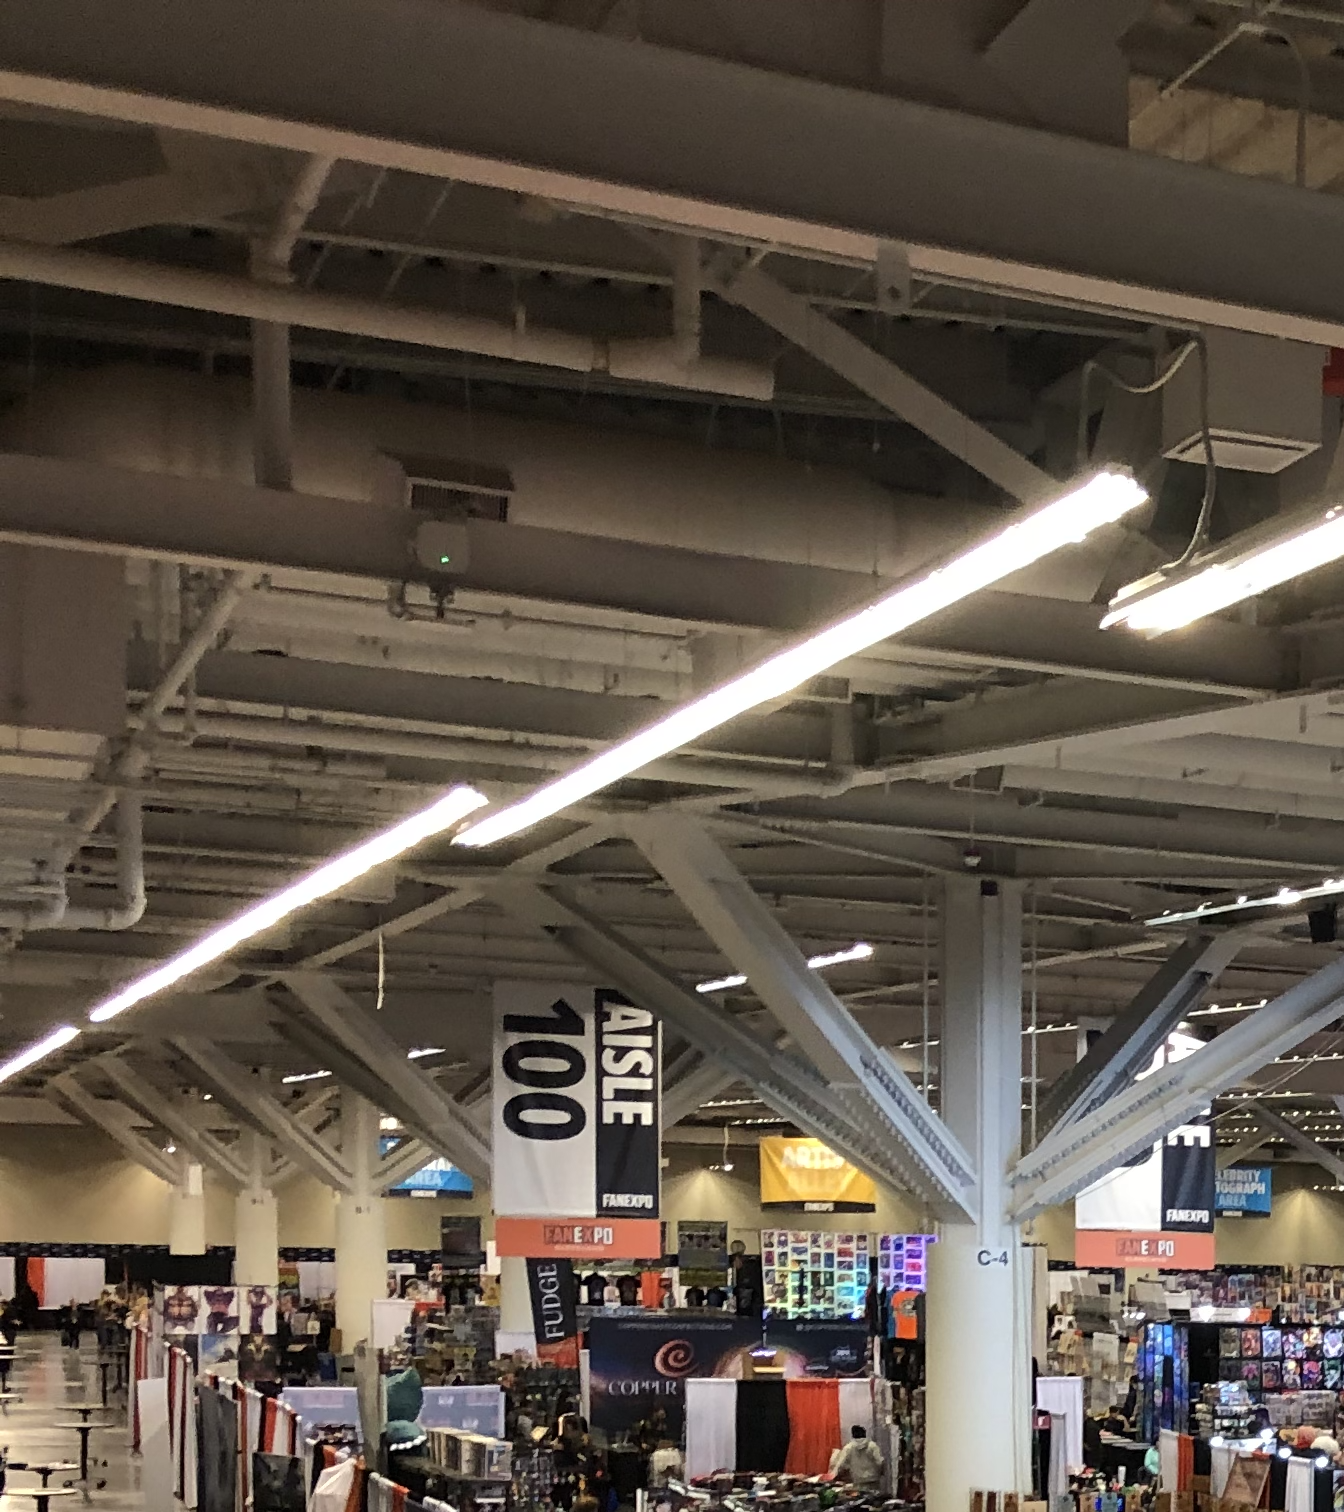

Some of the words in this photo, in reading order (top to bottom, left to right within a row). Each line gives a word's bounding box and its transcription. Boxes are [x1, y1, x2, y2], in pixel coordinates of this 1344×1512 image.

[502, 998, 587, 1140] 100
[602, 1001, 654, 1126] AISLE
[1215, 1181, 1266, 1194] TOGRAPH
[602, 1193, 653, 1209] FANEXPO
[1166, 1209, 1210, 1223] FANEXPO
[544, 1225, 613, 1245] FANEXPO
[1116, 1239, 1175, 1256] FANEXPO
[977, 1249, 1008, 1266] C-4
[537, 1263, 566, 1339] FUDGE
[608, 1380, 677, 1396] COPPER
